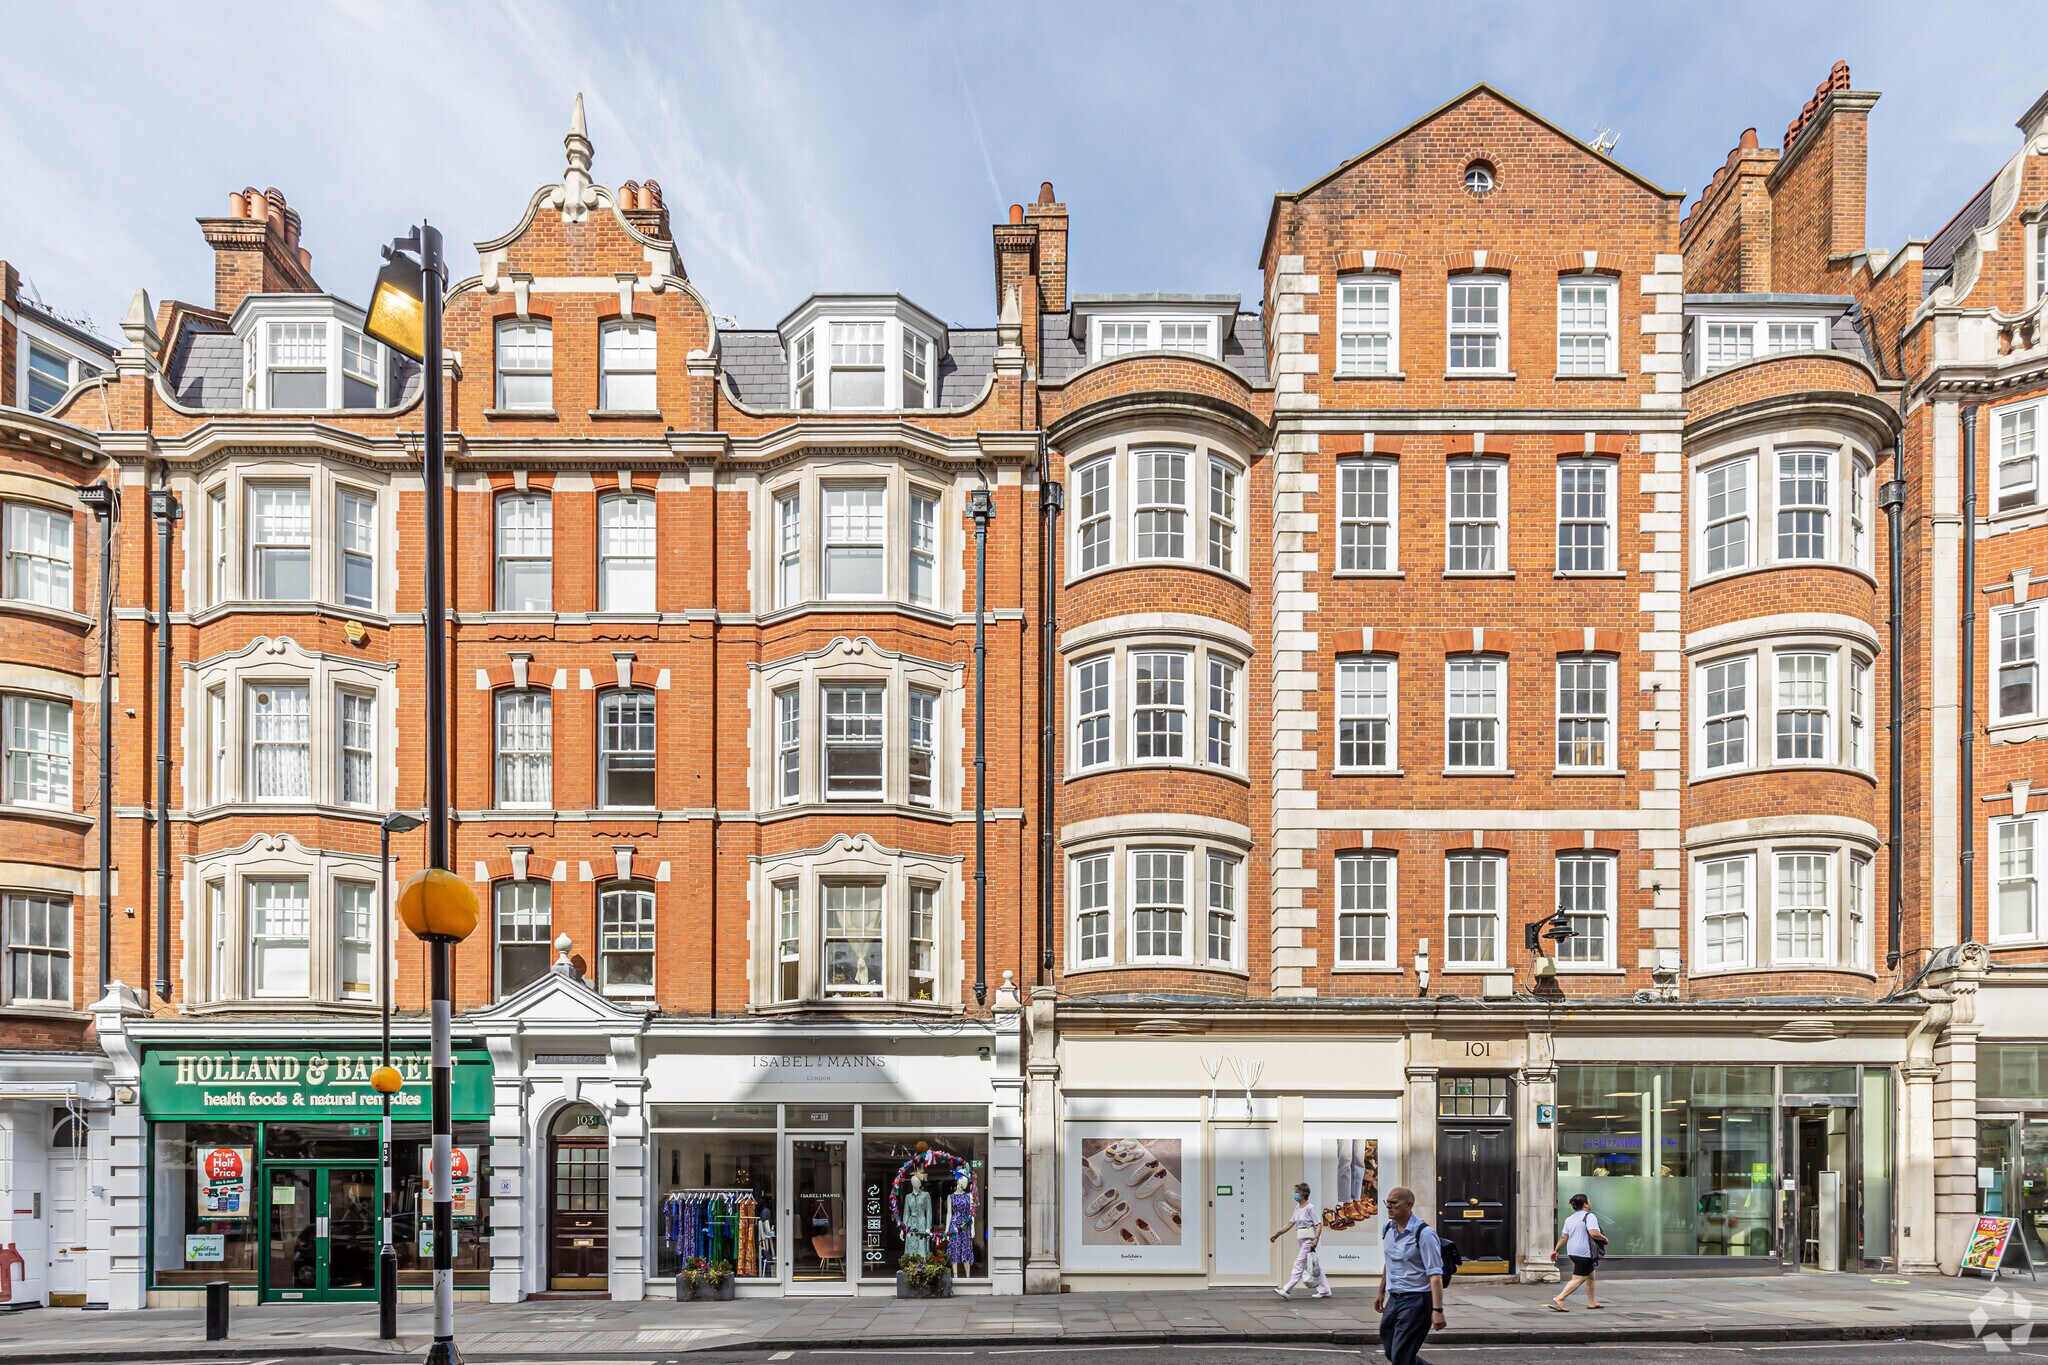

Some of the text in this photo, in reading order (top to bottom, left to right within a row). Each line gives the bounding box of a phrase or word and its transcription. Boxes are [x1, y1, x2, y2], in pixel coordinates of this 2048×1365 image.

[577, 1055, 605, 1063] HOUSE
[753, 1056, 886, 1067] ISABEL MANNS
[175, 1056, 300, 1085] HOLLAND
[305, 1056, 329, 1085] &
[204, 1092, 422, 1106] health foods & natural remedies
[577, 1115, 595, 1126] 103
[213, 1158, 235, 1168] Half
[213, 1168, 237, 1177] Price
